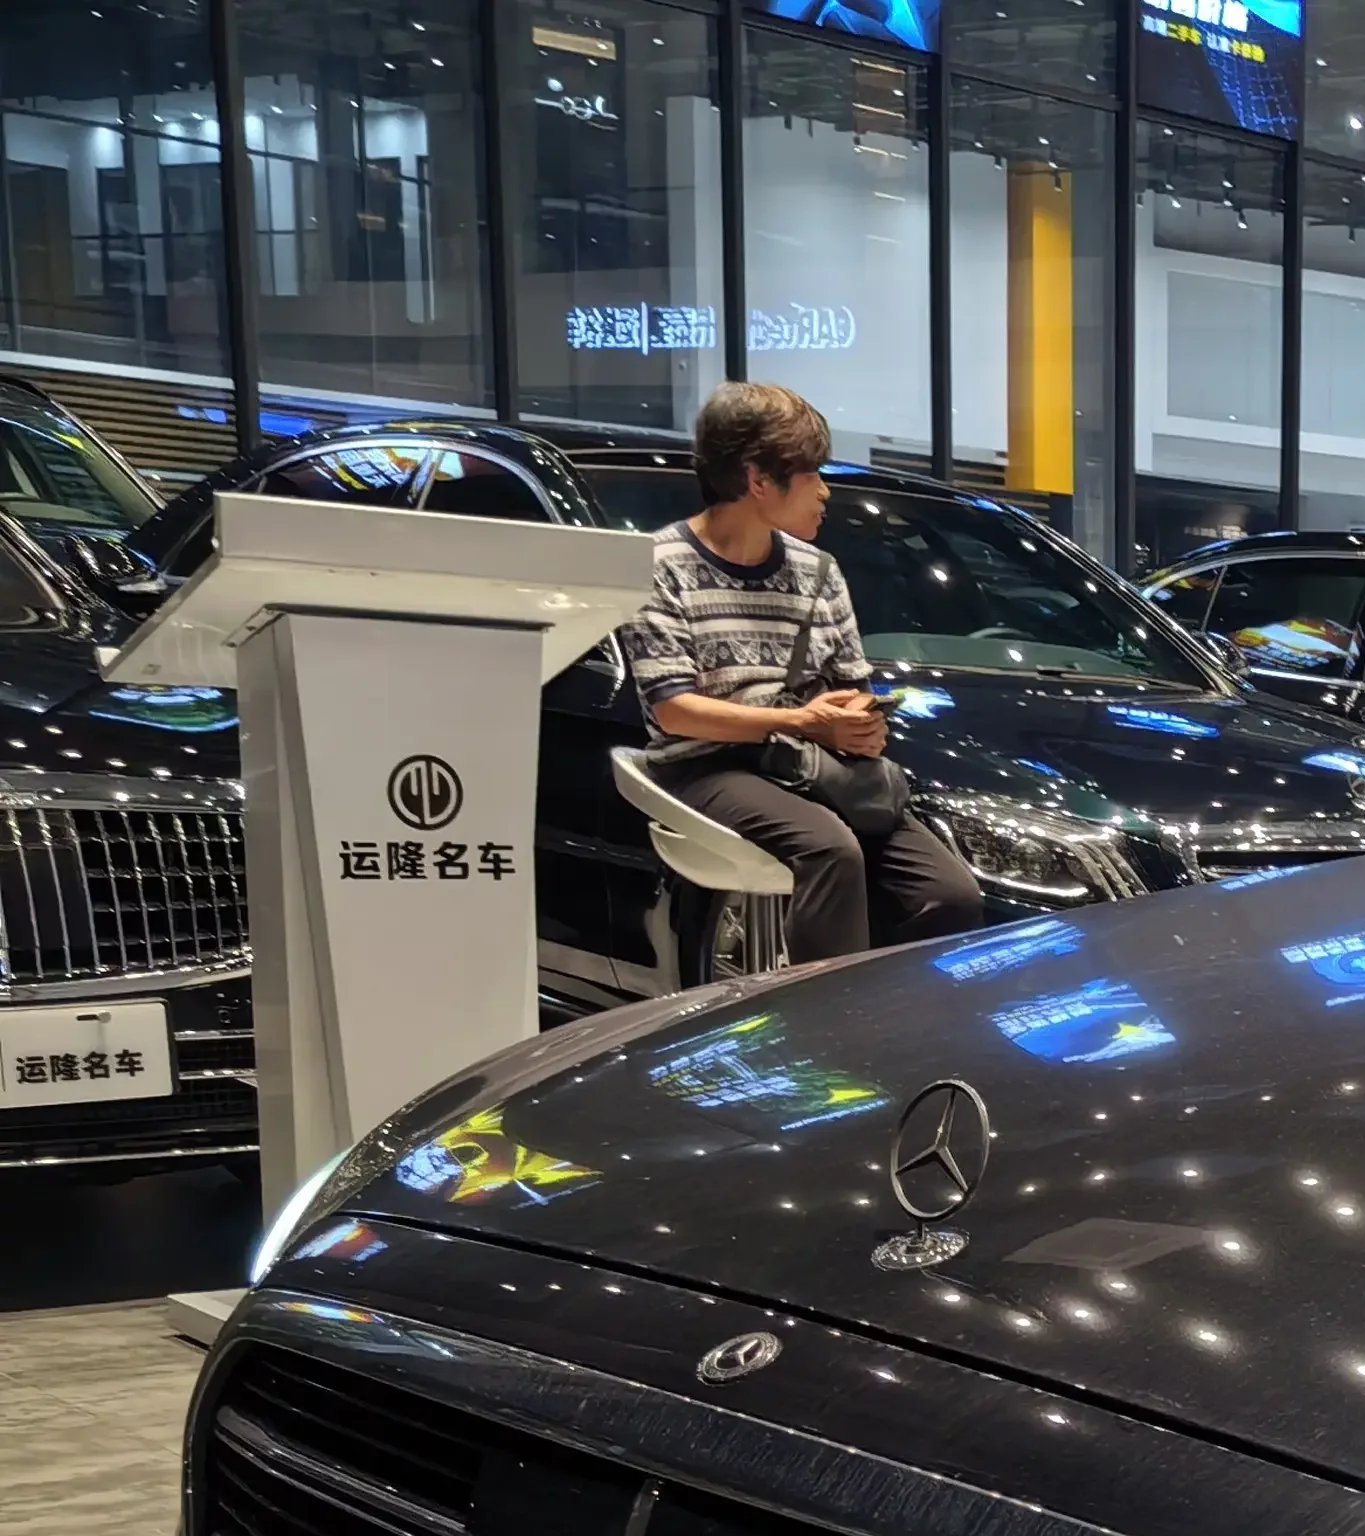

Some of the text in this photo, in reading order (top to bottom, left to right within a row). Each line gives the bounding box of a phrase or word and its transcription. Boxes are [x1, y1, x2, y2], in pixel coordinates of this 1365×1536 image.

[339, 841, 517, 882] 运隆名车
[15, 1049, 146, 1085] 运隆名车
